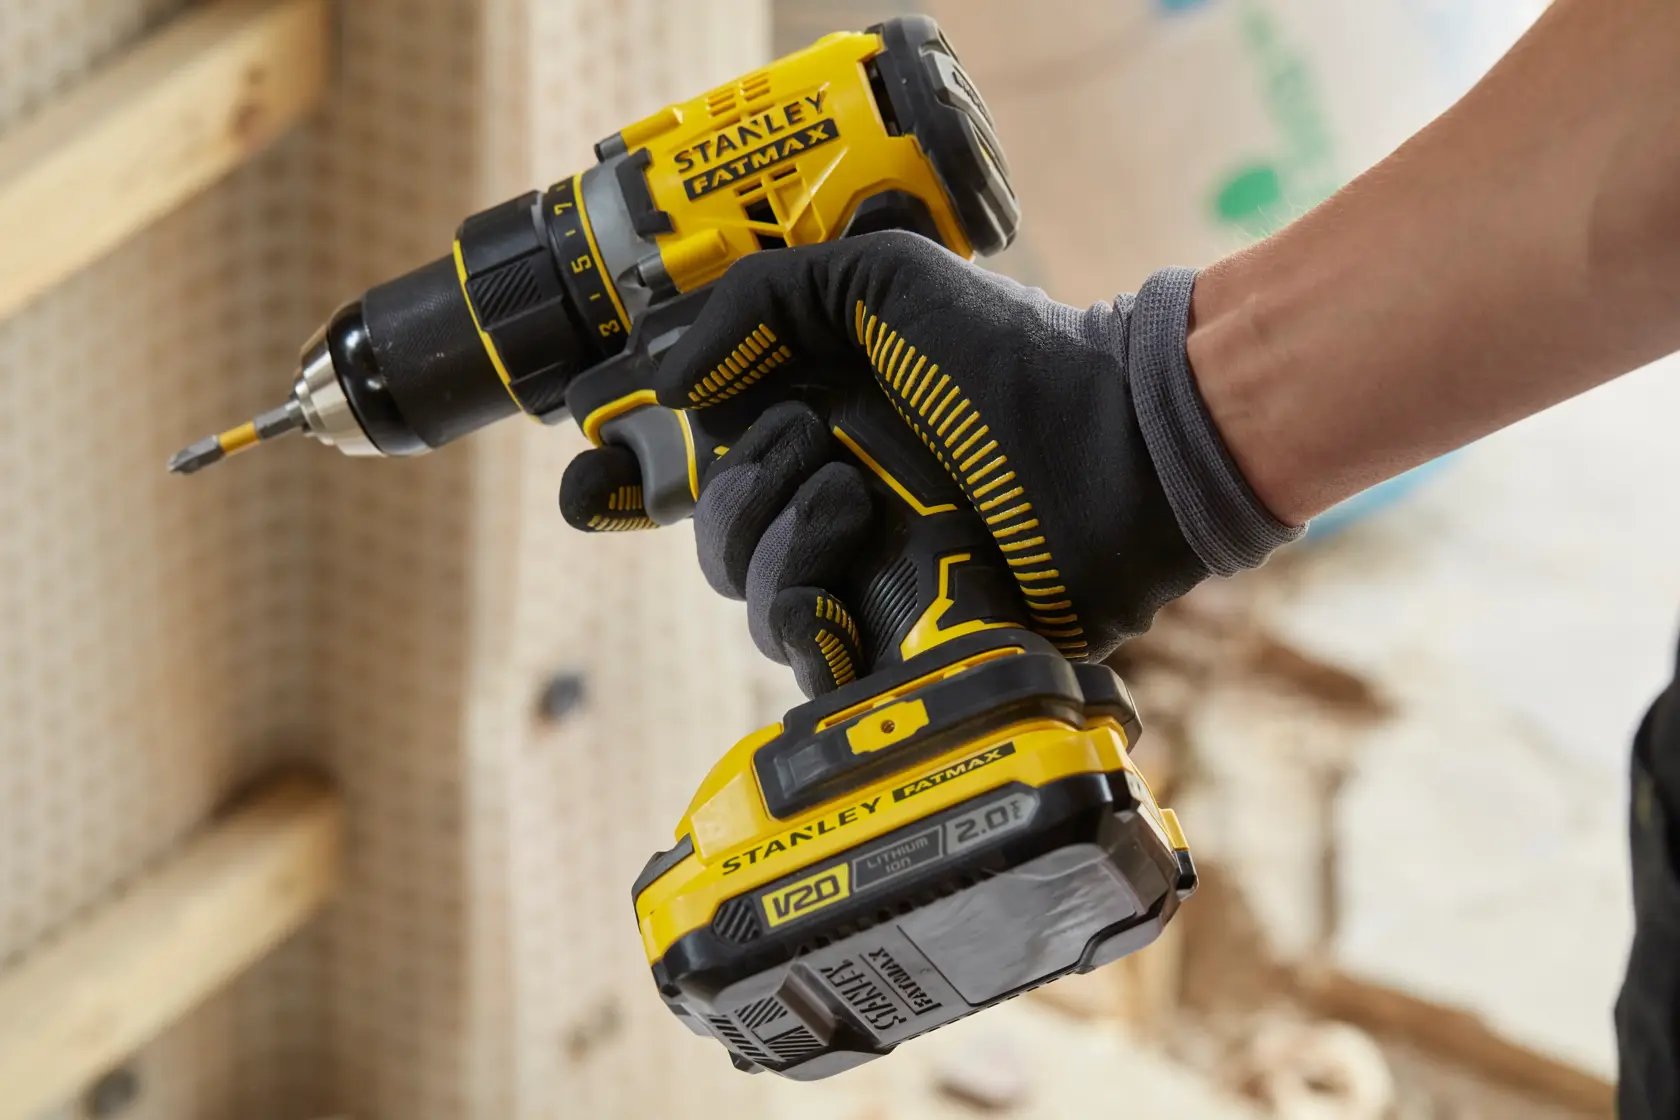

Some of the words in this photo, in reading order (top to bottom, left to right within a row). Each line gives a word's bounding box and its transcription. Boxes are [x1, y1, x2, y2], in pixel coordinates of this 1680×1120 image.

[674, 90, 826, 173] STANLEY
[690, 123, 830, 196] FATMAX
[554, 202, 573, 216] 7
[571, 255, 592, 274] 5
[599, 319, 620, 337] 3
[722, 796, 881, 876] STANLEY
[902, 748, 1004, 797] FATMAX
[955, 806, 1009, 844] 2.0
[772, 875, 840, 920] V20
[820, 959, 907, 1030] STANLEY
[868, 947, 933, 1007] FATMAX
